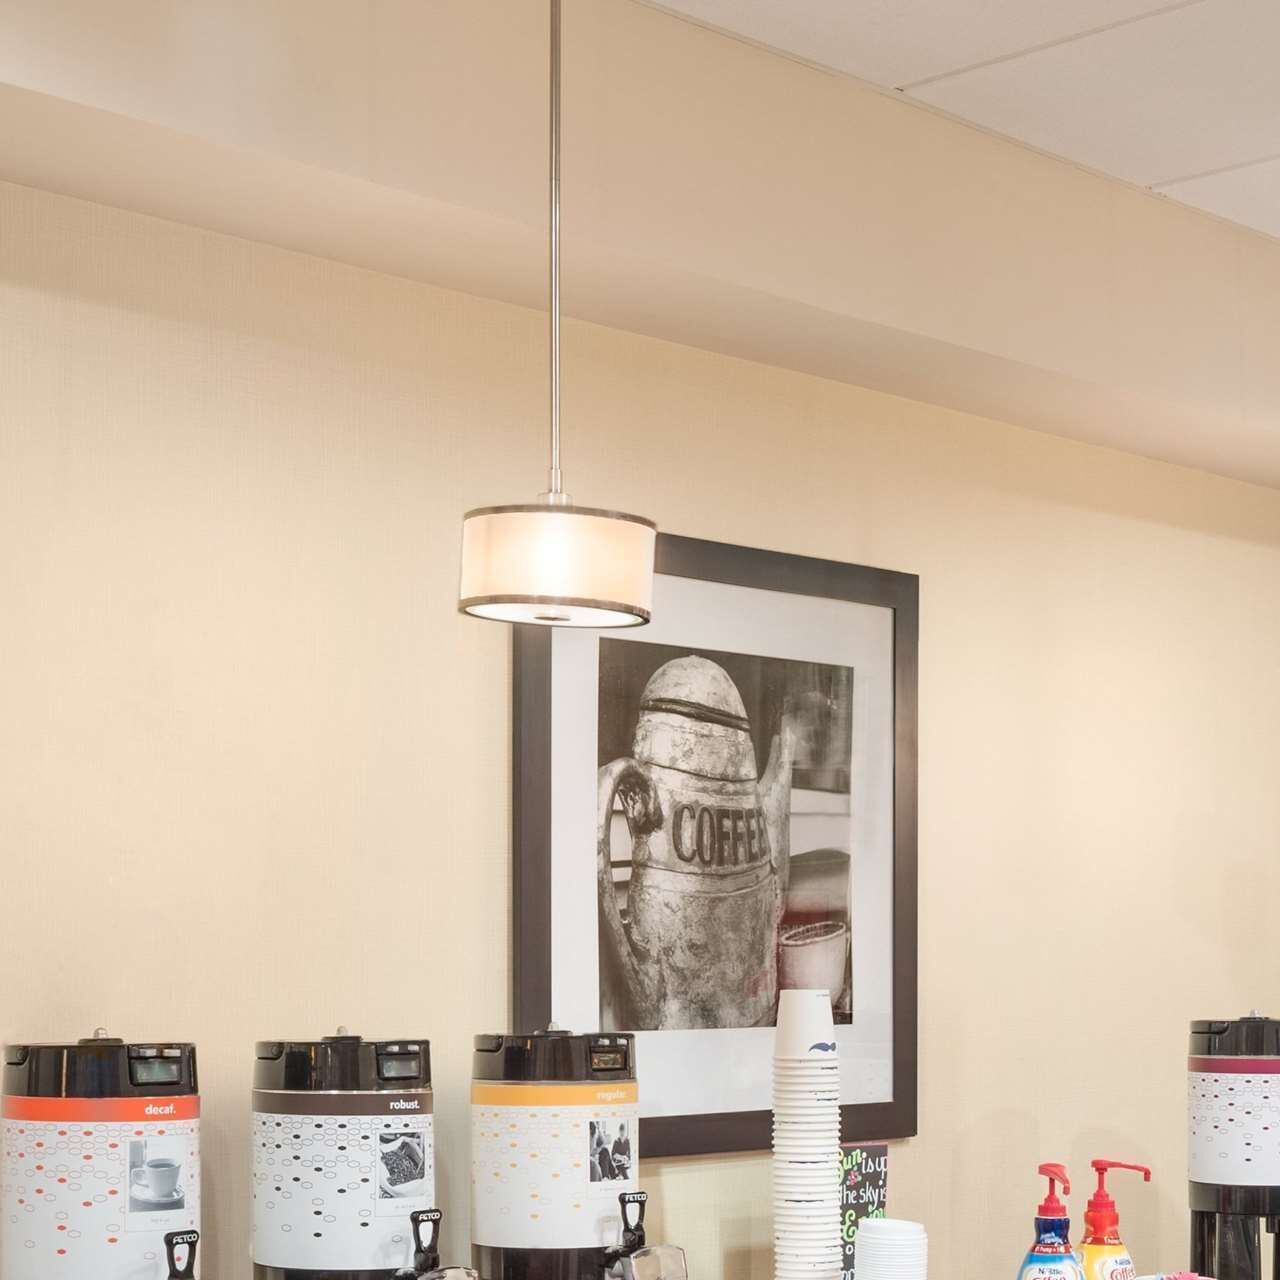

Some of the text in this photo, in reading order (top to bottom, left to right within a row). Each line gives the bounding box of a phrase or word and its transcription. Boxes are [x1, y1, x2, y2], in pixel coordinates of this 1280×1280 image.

[671, 803, 768, 866] COFFEE
[144, 1103, 177, 1115] decaf.
[389, 1099, 420, 1110] robust.
[862, 1152, 874, 1174] is
[859, 1181, 879, 1212] sky
[172, 1233, 198, 1244] FETCO
